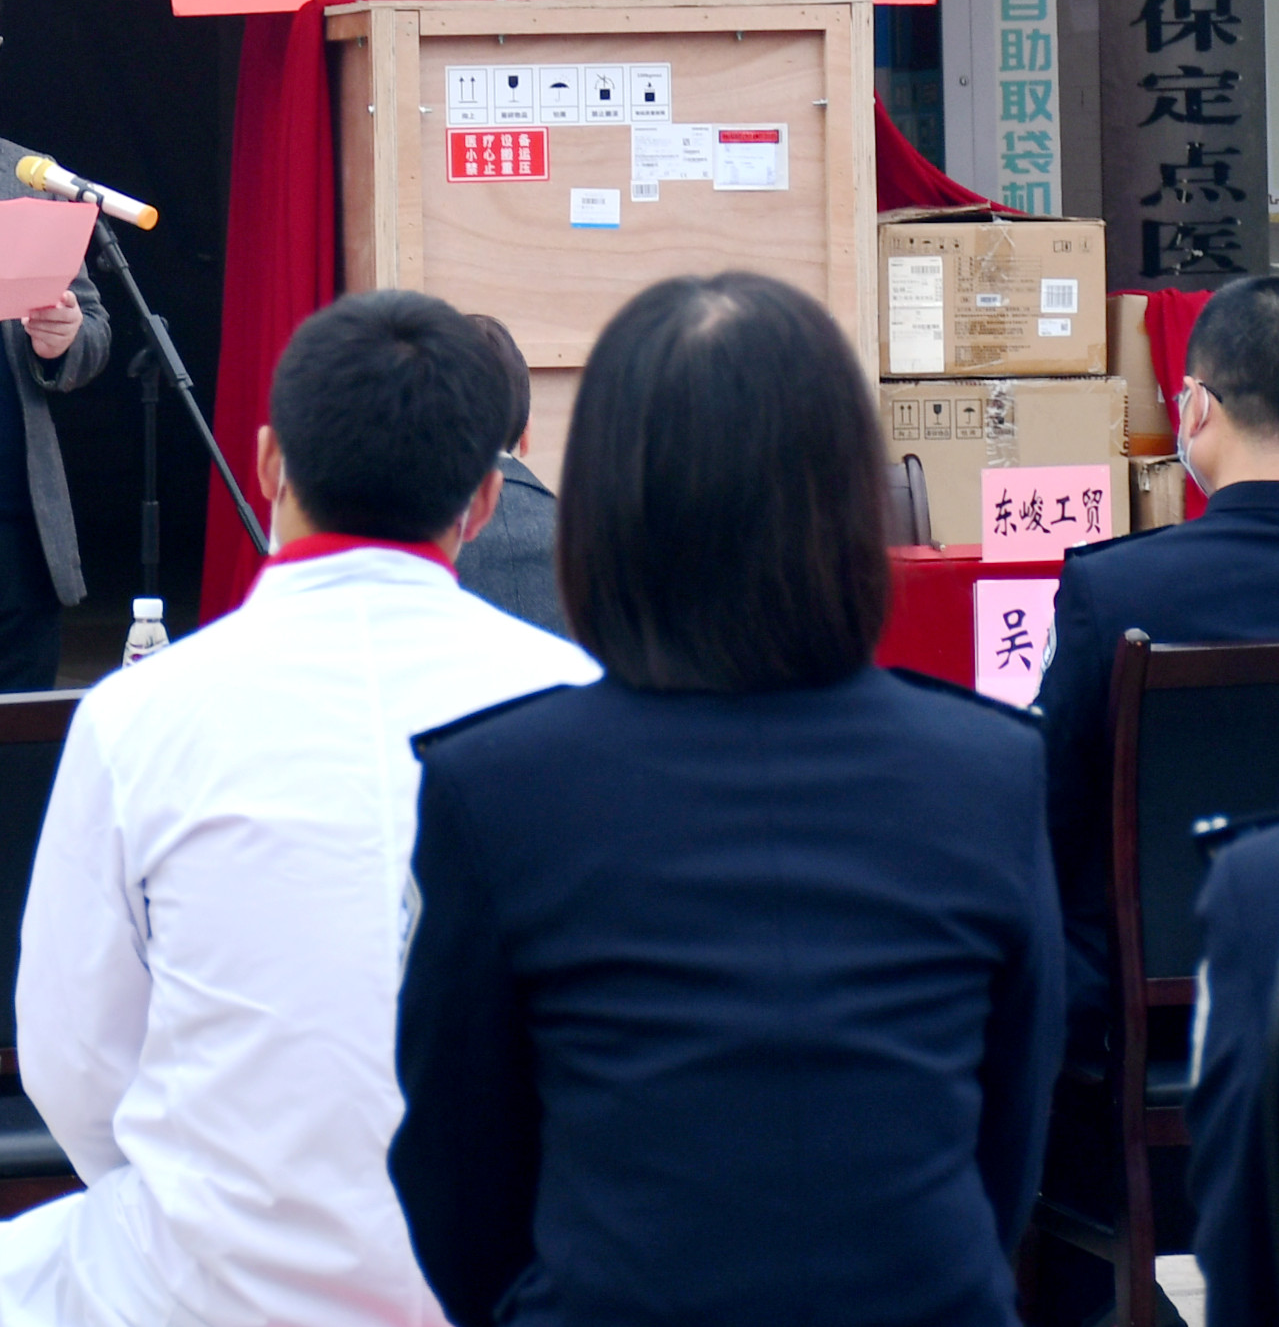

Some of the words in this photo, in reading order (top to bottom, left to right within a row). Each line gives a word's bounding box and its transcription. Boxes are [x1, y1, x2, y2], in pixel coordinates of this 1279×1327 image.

[465, 134, 531, 148] 医疗设备
[465, 148, 531, 161] 小心搬运
[465, 161, 531, 175] 禁止重压
[992, 488, 1105, 536] 东峻工贸
[996, 608, 1034, 671] 吴
